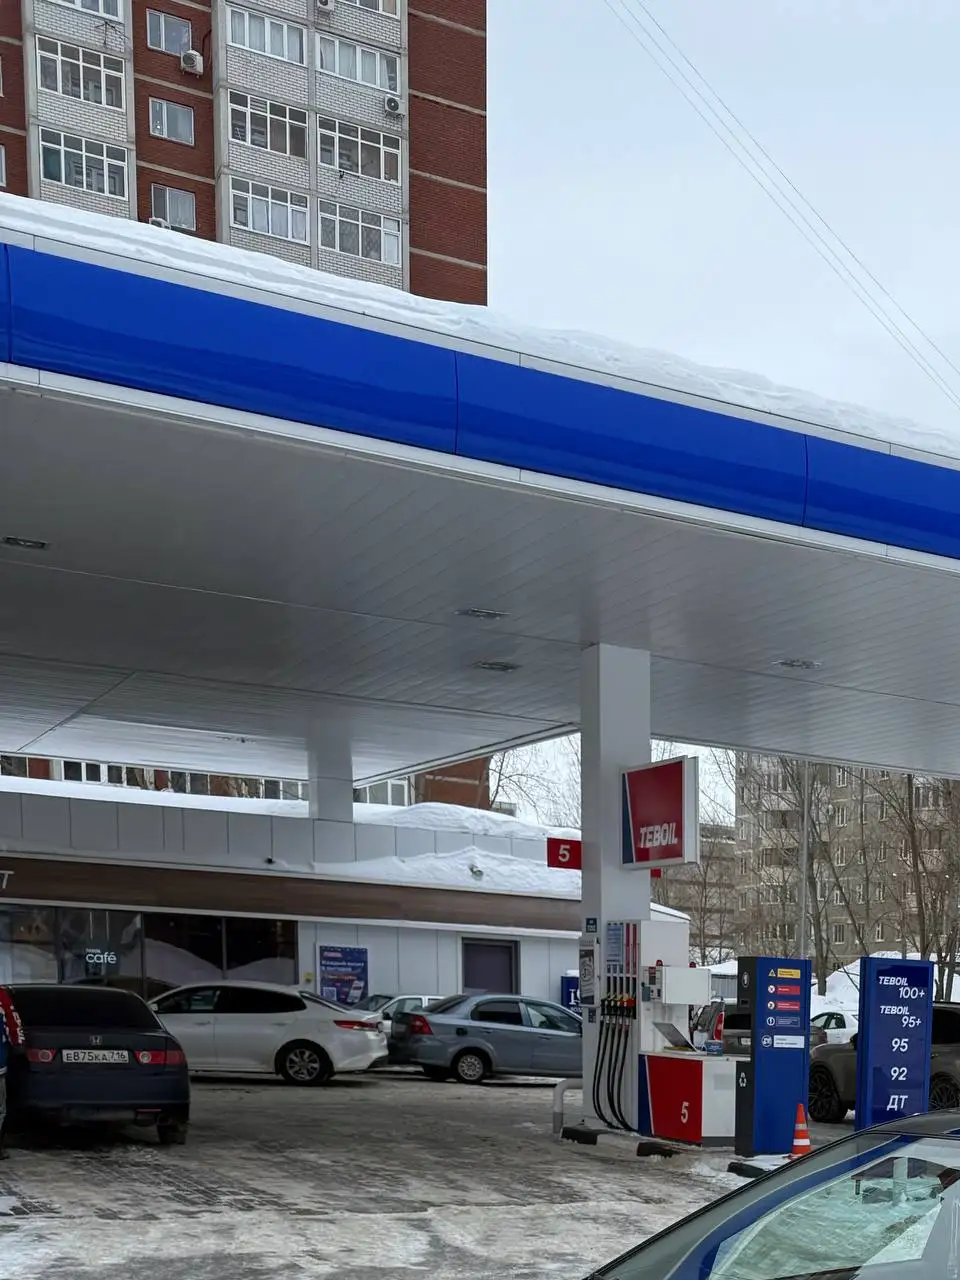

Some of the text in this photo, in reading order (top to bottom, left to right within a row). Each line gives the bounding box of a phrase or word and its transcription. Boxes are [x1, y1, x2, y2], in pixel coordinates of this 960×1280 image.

[638, 822, 679, 849] TEBOIL
[558, 843, 571, 862] 5
[86, 951, 117, 964] café
[878, 976, 909, 986] TEBOIL
[898, 986, 925, 999] 100+
[879, 1005, 910, 1015] TEBOIL
[901, 1015, 922, 1028] 95+
[891, 1038, 909, 1052] 95
[890, 1066, 908, 1081] 92
[886, 1095, 909, 1111] ДТ
[680, 1101, 690, 1124] 5
